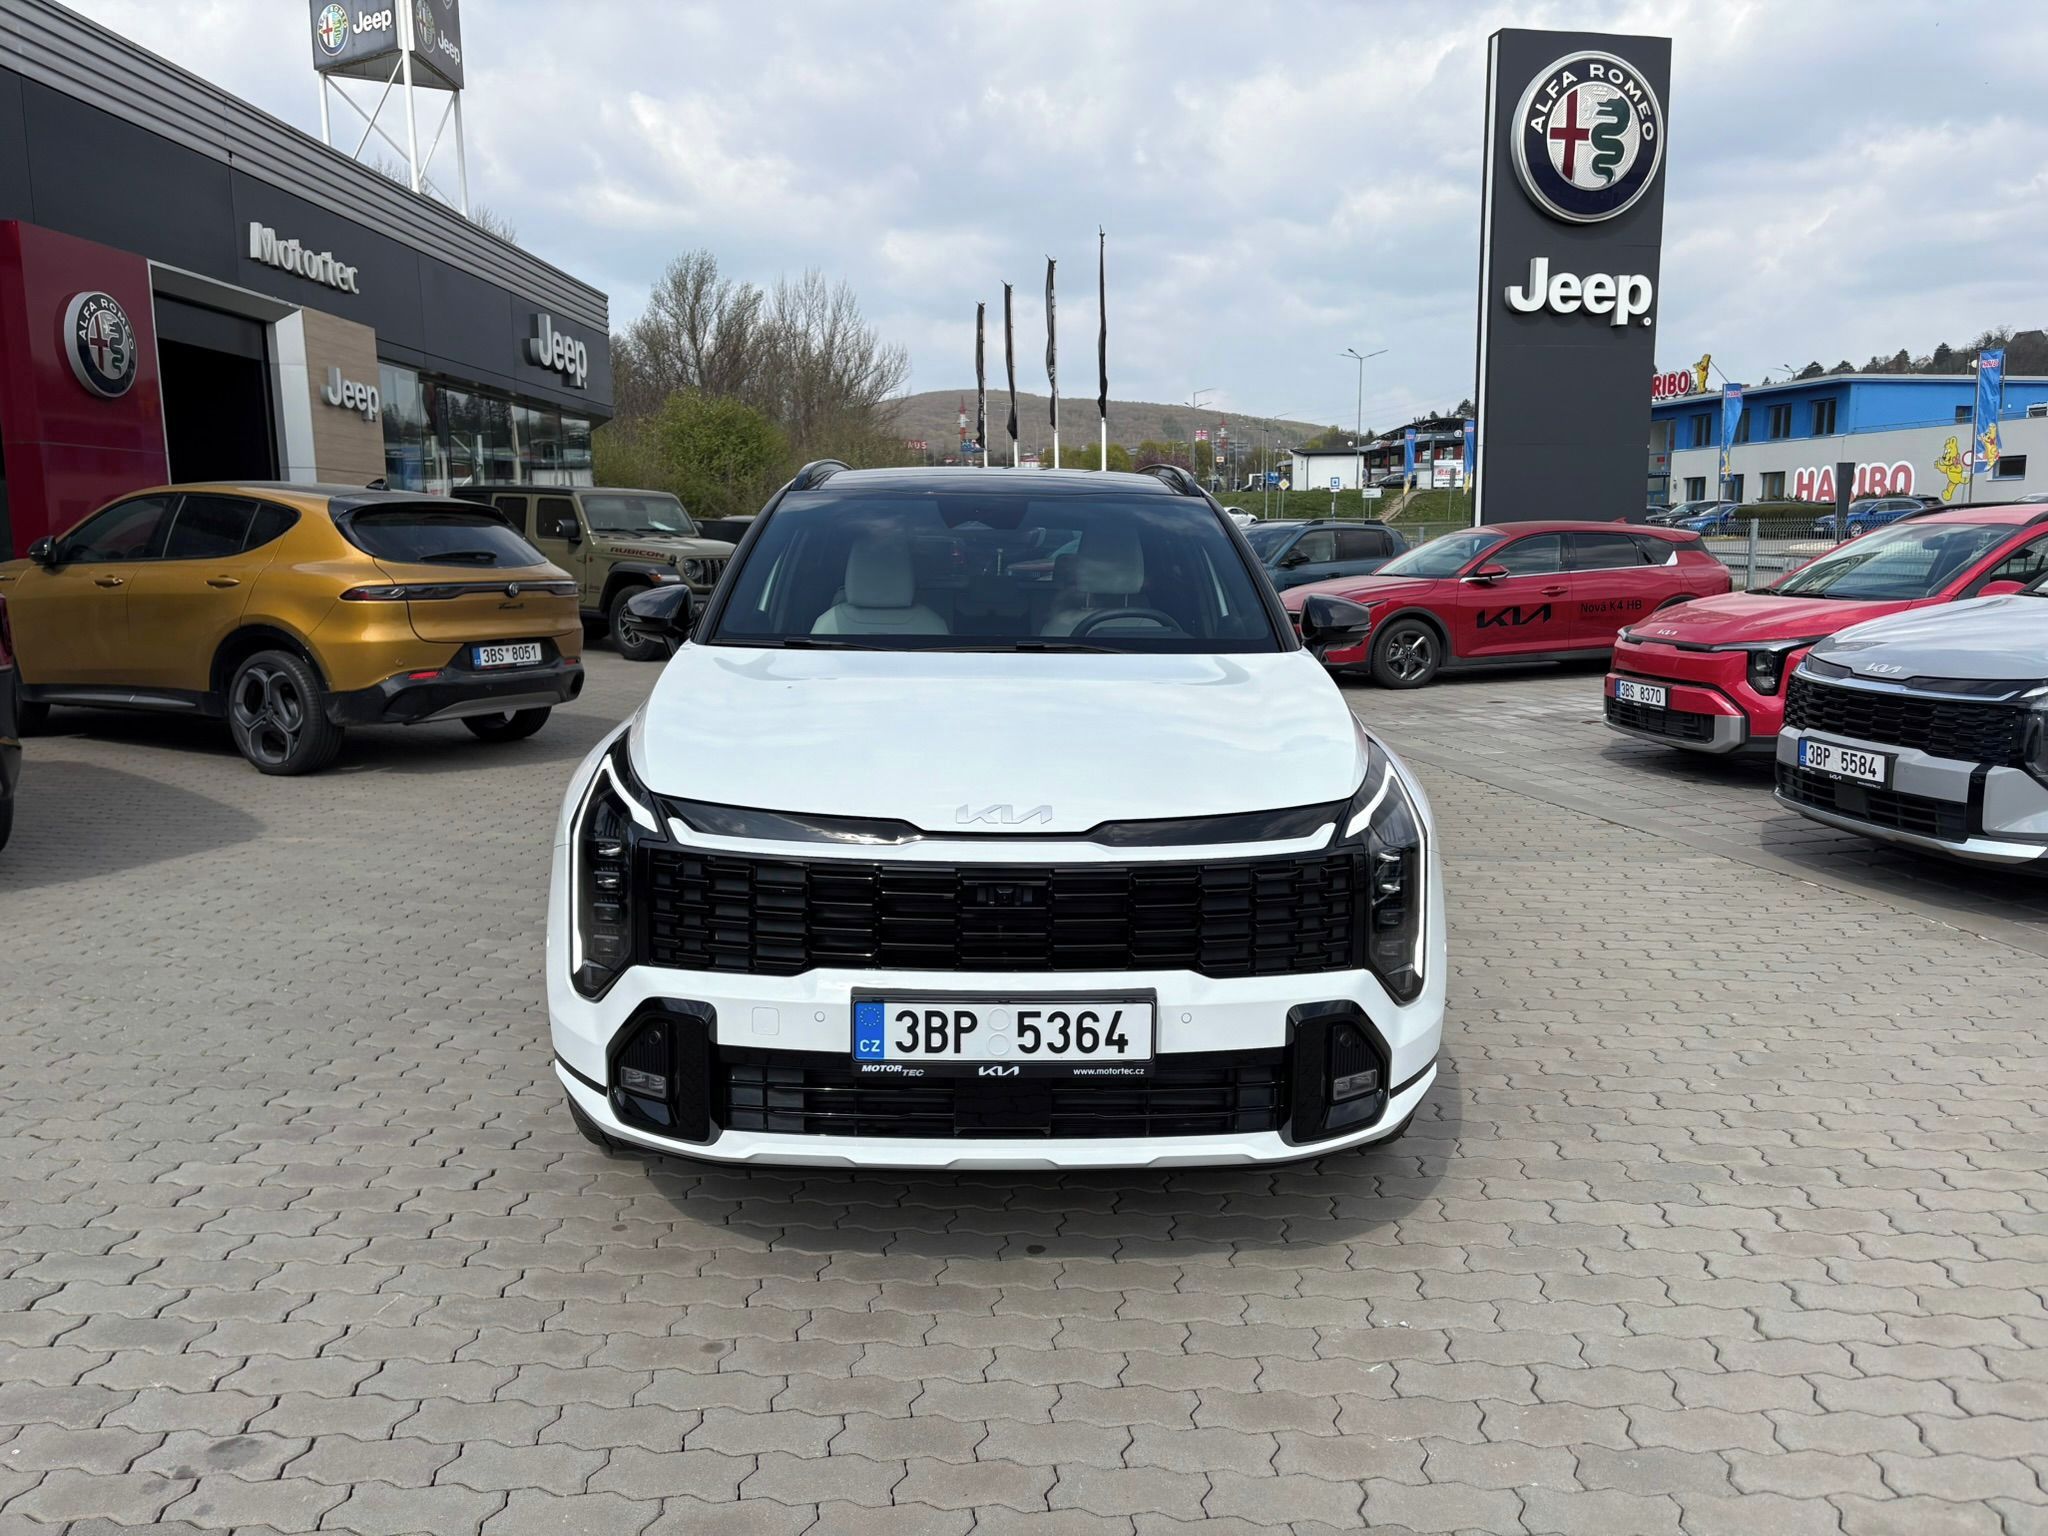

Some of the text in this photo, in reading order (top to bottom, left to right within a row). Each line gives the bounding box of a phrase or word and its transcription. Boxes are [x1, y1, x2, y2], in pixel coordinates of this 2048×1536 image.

[353, 9, 392, 34] Jeep
[438, 30, 460, 65] Jeep
[1531, 64, 1654, 141] ALFA ROMEO
[249, 222, 360, 294] Motortec
[1506, 257, 1653, 326] Jeep
[79, 298, 134, 350] ALFA ROMEO
[530, 313, 588, 389] Jeep
[326, 367, 380, 421] Jeep
[1652, 370, 1690, 398] RIBO
[1794, 462, 1915, 502] HAIBO
[610, 547, 665, 558] RUBICON
[1627, 600, 1642, 610] HB
[483, 648, 505, 664] 3BS
[511, 645, 537, 661] 8051
[1621, 683, 1661, 703] 3BS 8370
[1808, 744, 1877, 778] 3BP 5584
[860, 1039, 881, 1052] CZ
[895, 1010, 1129, 1054] 3BP 5364
[1073, 1067, 1145, 1076] www.motortec.cz
